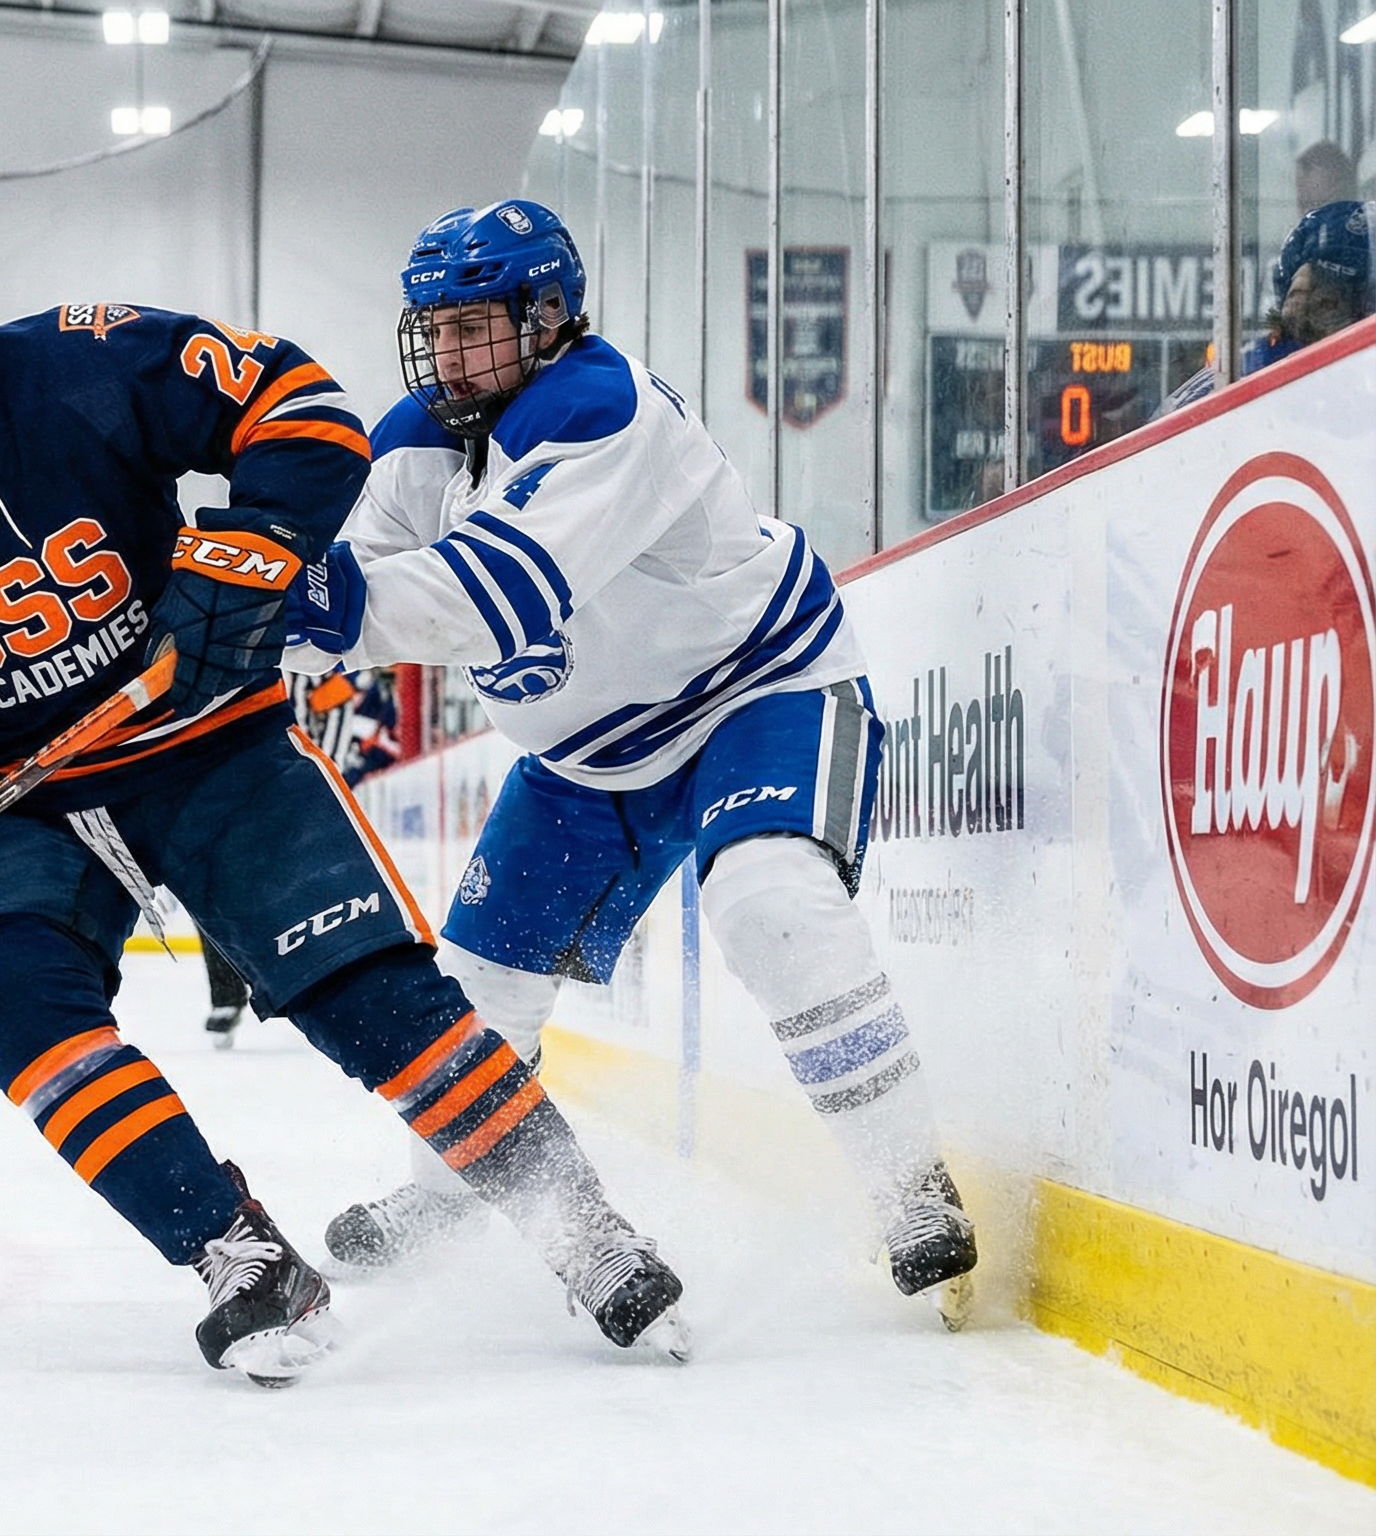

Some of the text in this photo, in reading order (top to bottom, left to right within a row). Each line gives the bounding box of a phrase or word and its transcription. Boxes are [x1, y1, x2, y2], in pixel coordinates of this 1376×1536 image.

[172, 535, 288, 584] CCM
[927, 644, 1025, 839] Health
[701, 785, 798, 830] CCM
[274, 892, 380, 957] CCM
[1190, 1050, 1238, 1155] Hor
